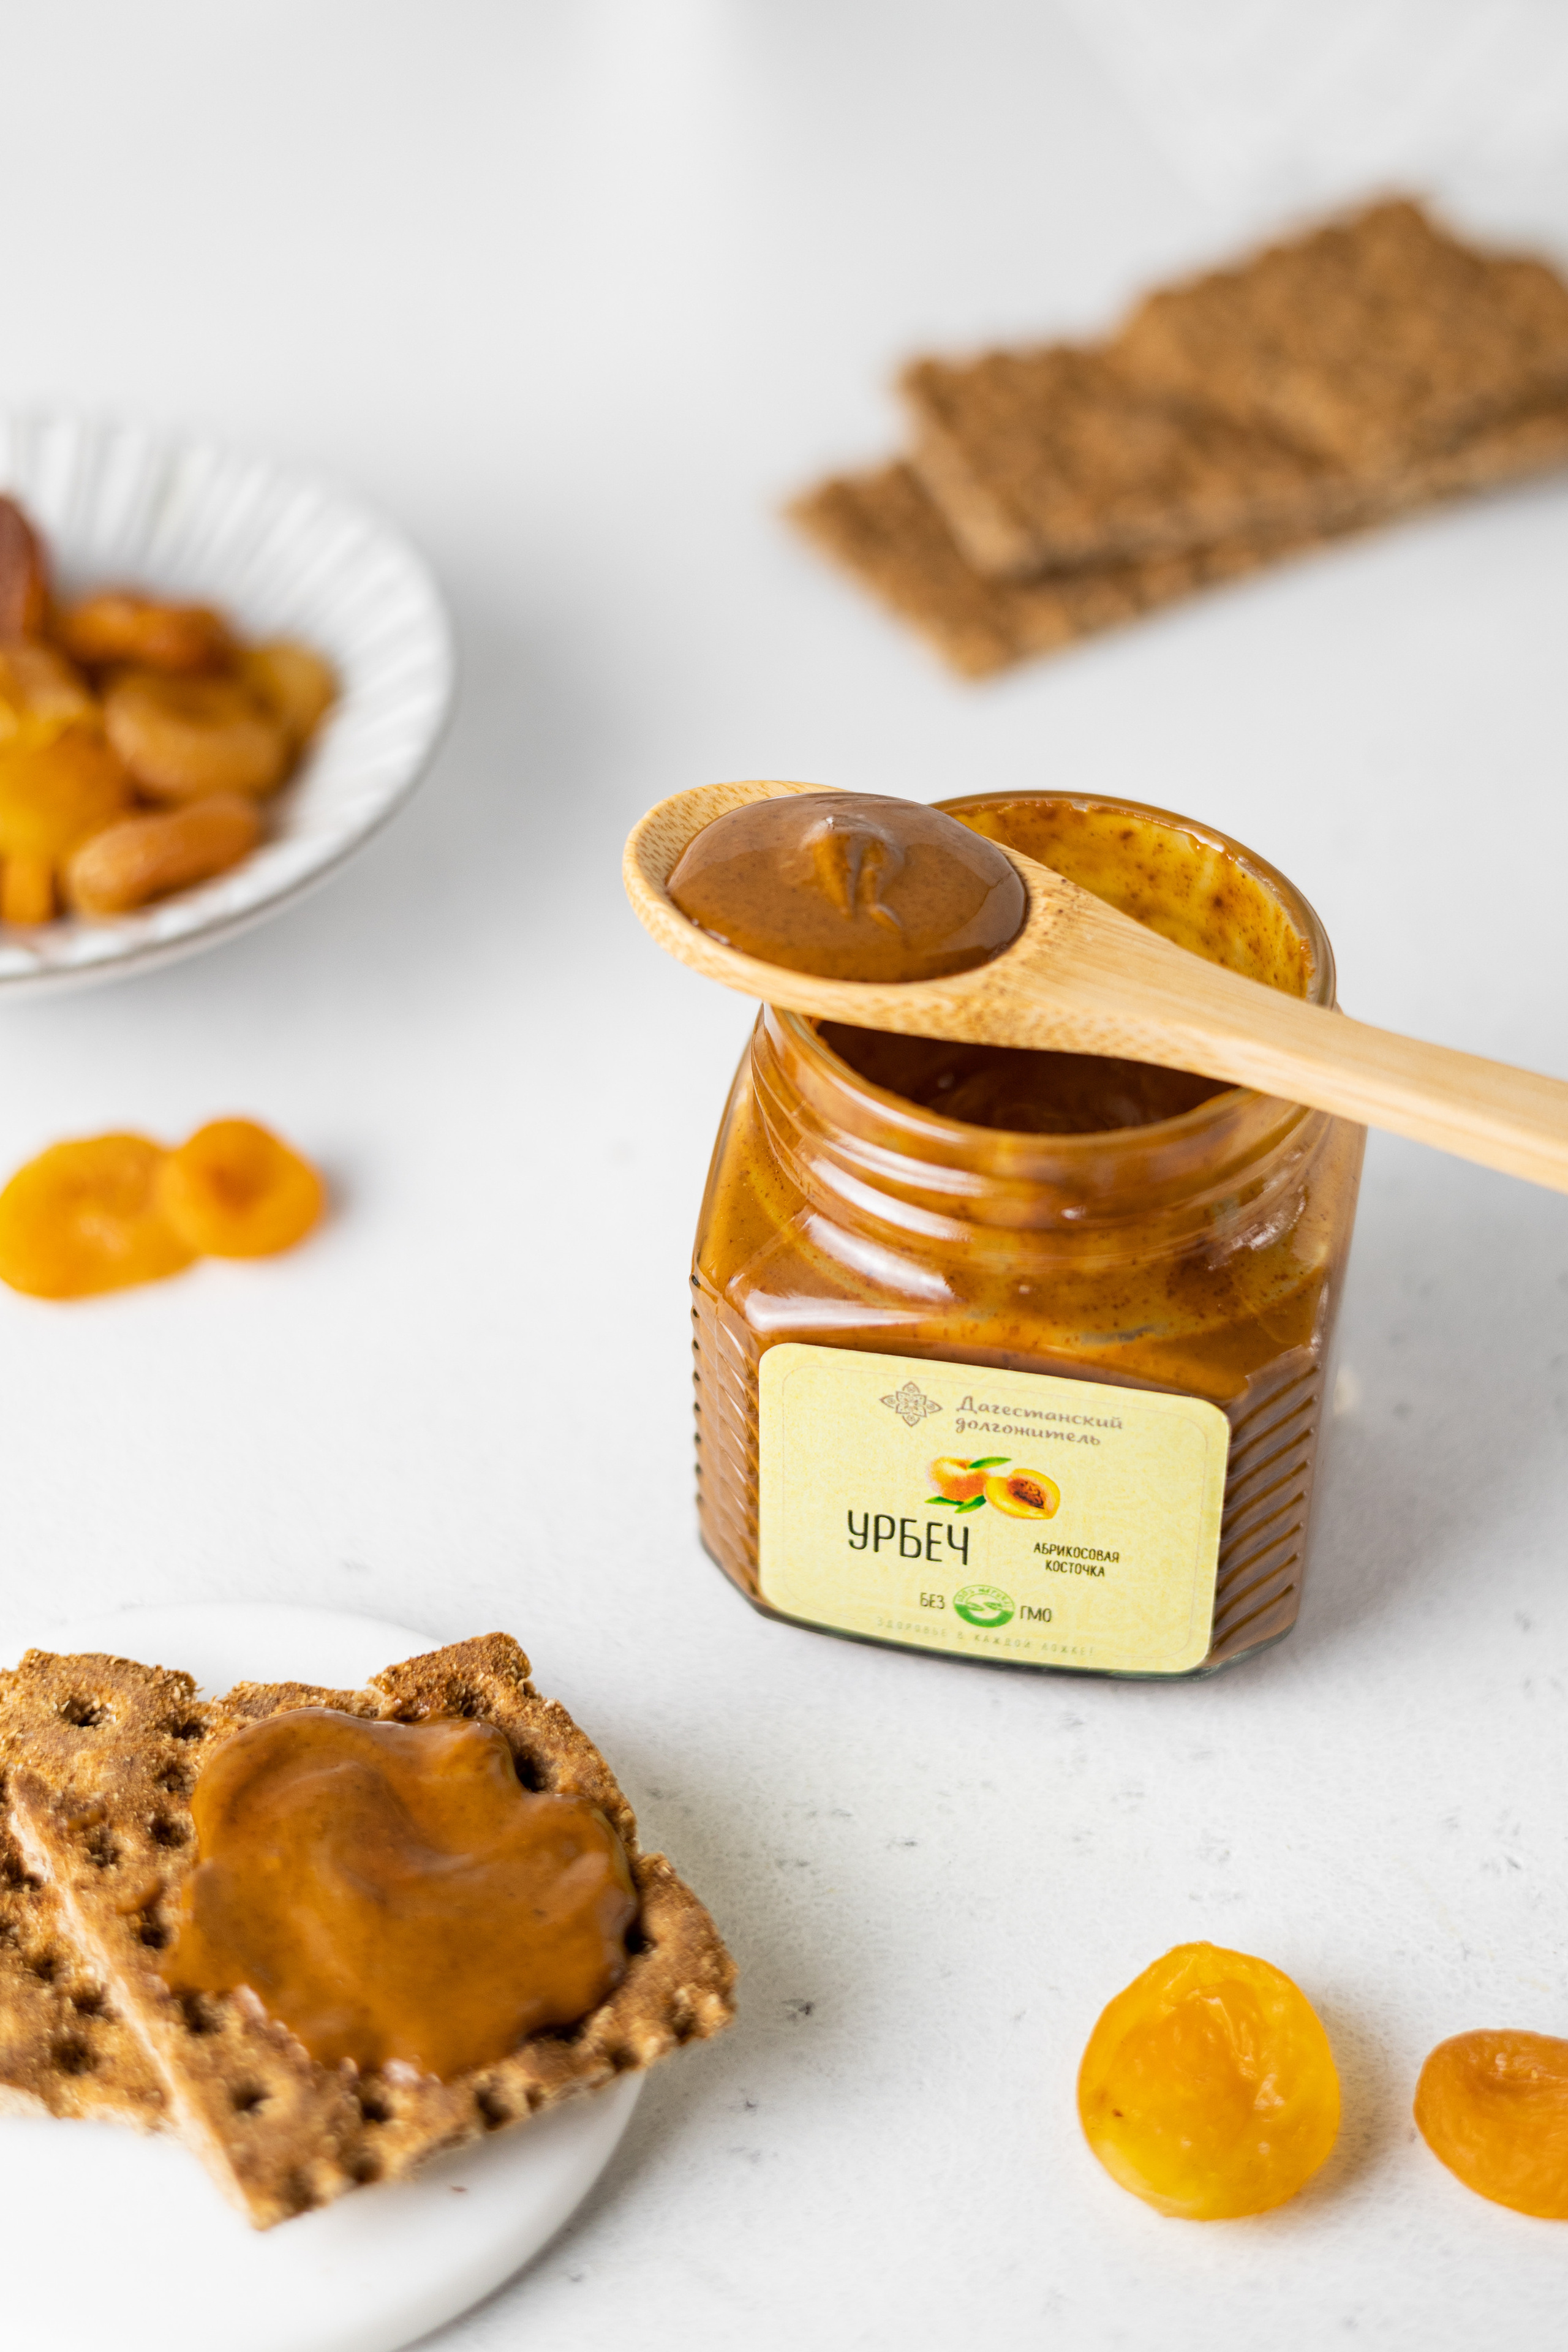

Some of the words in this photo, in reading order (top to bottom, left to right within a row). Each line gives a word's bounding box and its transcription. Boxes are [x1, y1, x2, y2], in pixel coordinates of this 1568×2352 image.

[956, 1395, 1123, 1430] Дагестанский
[956, 1417, 1101, 1446] долгожитель
[847, 1510, 969, 1566] УРБЕЧ
[1033, 1542, 1120, 1563] АБРИКОСОВАЯ
[1046, 1560, 1106, 1577] КОСТОЧКА
[920, 1593, 945, 1609] БЕЗ
[1020, 1605, 1052, 1622] ГМО
[876, 1616, 948, 1637] ЗДОРОВЬЕ
